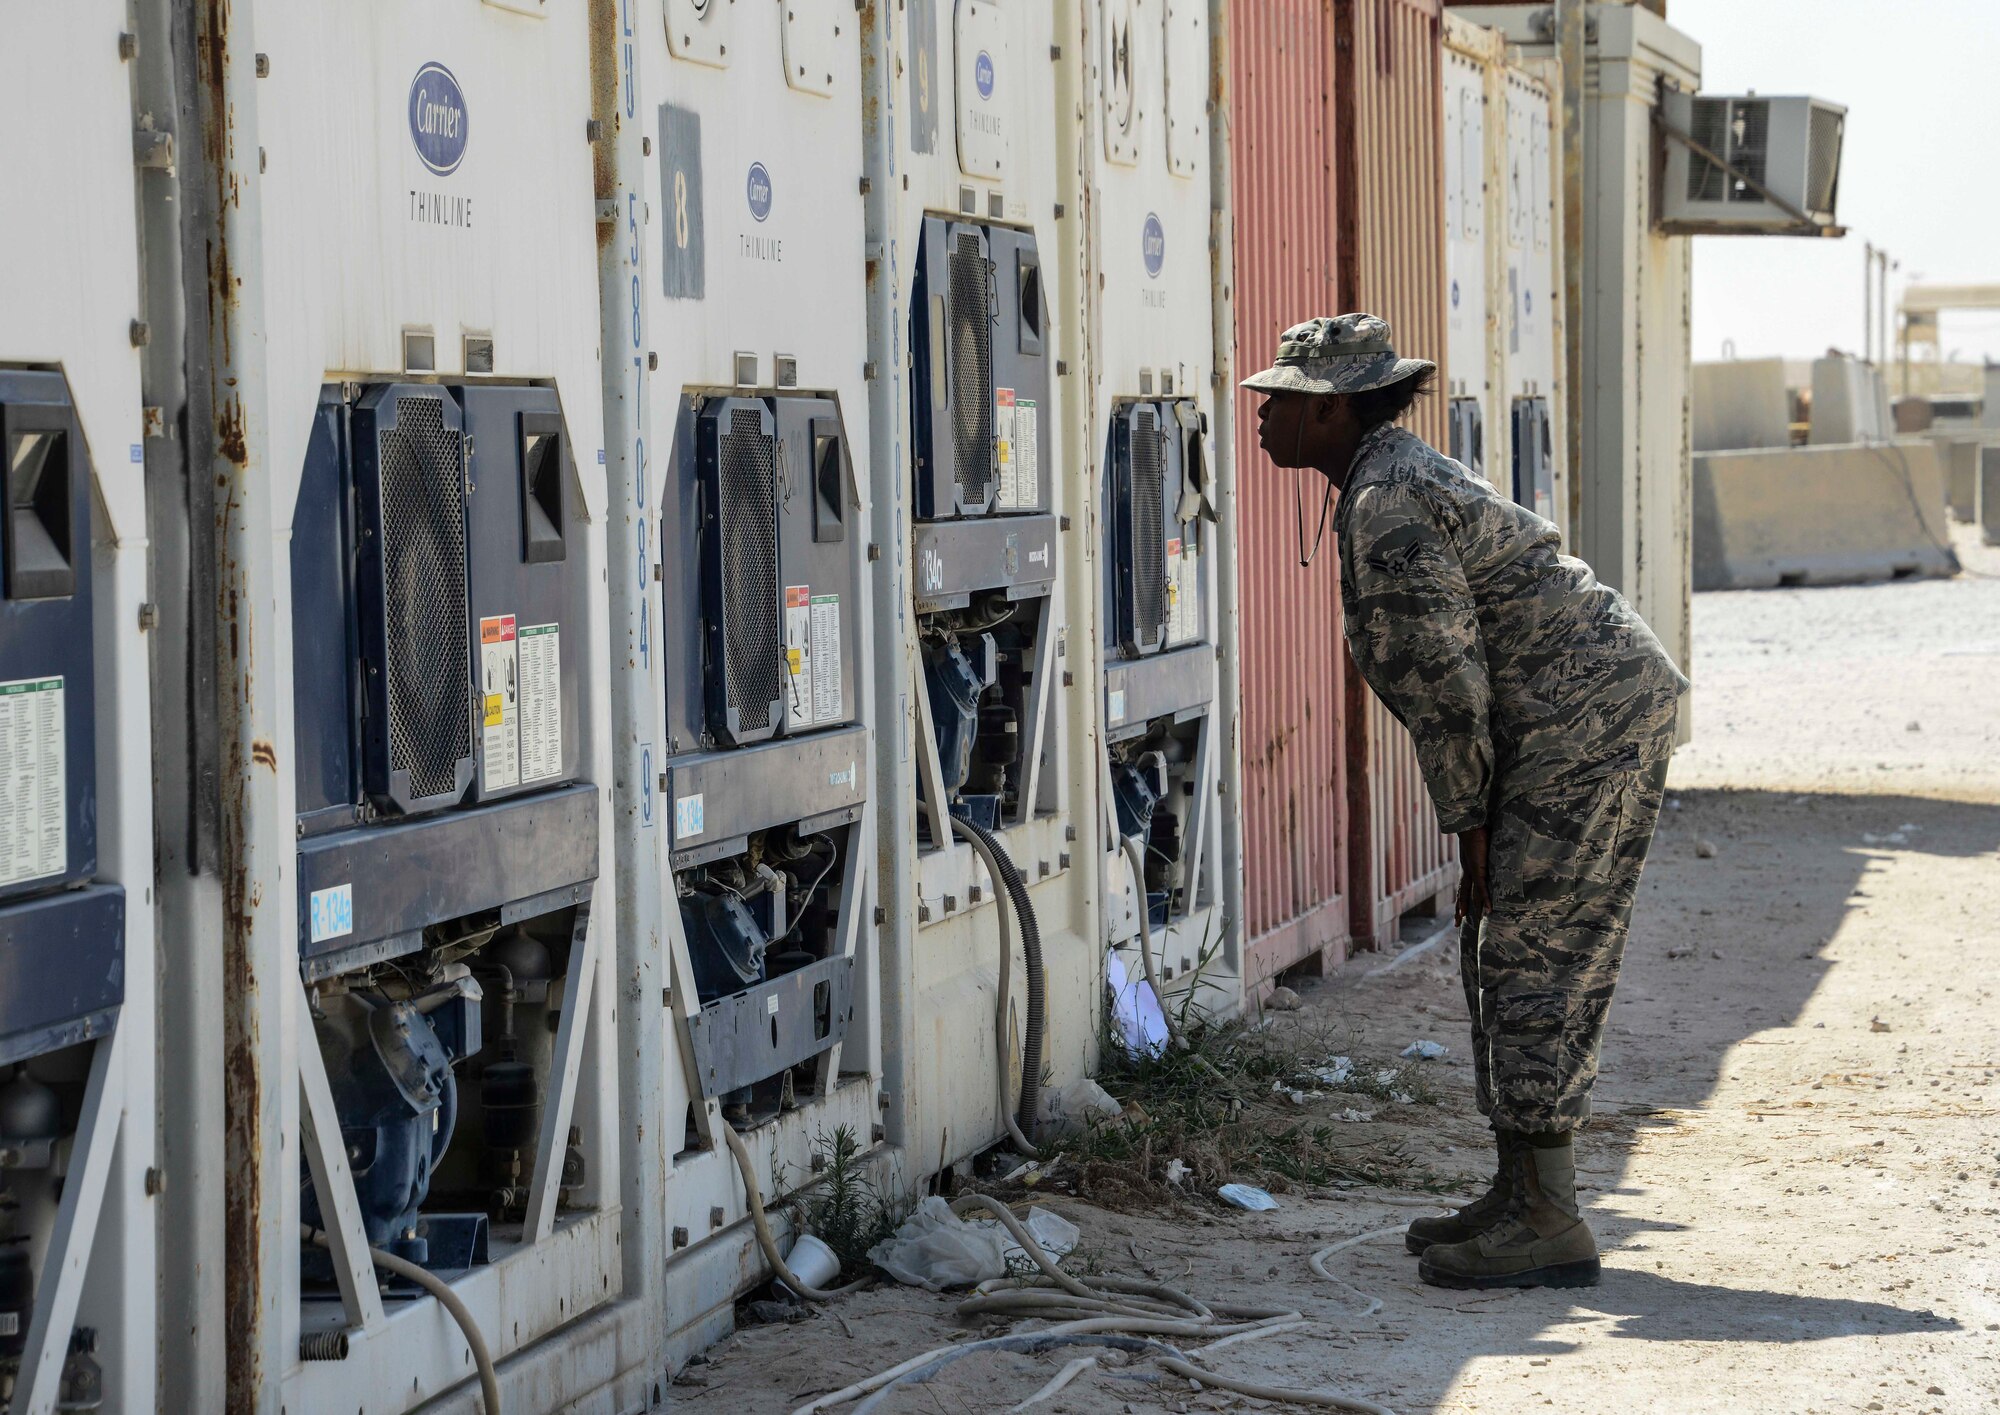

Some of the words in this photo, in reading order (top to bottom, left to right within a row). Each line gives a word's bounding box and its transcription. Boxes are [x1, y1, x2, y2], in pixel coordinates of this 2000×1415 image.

[918, 47, 929, 113] 9
[416, 88, 461, 139] Carrier
[969, 109, 1001, 136] THINLINE
[410, 190, 472, 228] THINLINE
[675, 169, 688, 249] 8
[749, 176, 769, 203] Carrier
[740, 234, 782, 262] THINLINE
[629, 192, 648, 670] 587084
[643, 749, 651, 821] 9
[677, 799, 704, 835] R-134a
[312, 890, 351, 937] R-134a
